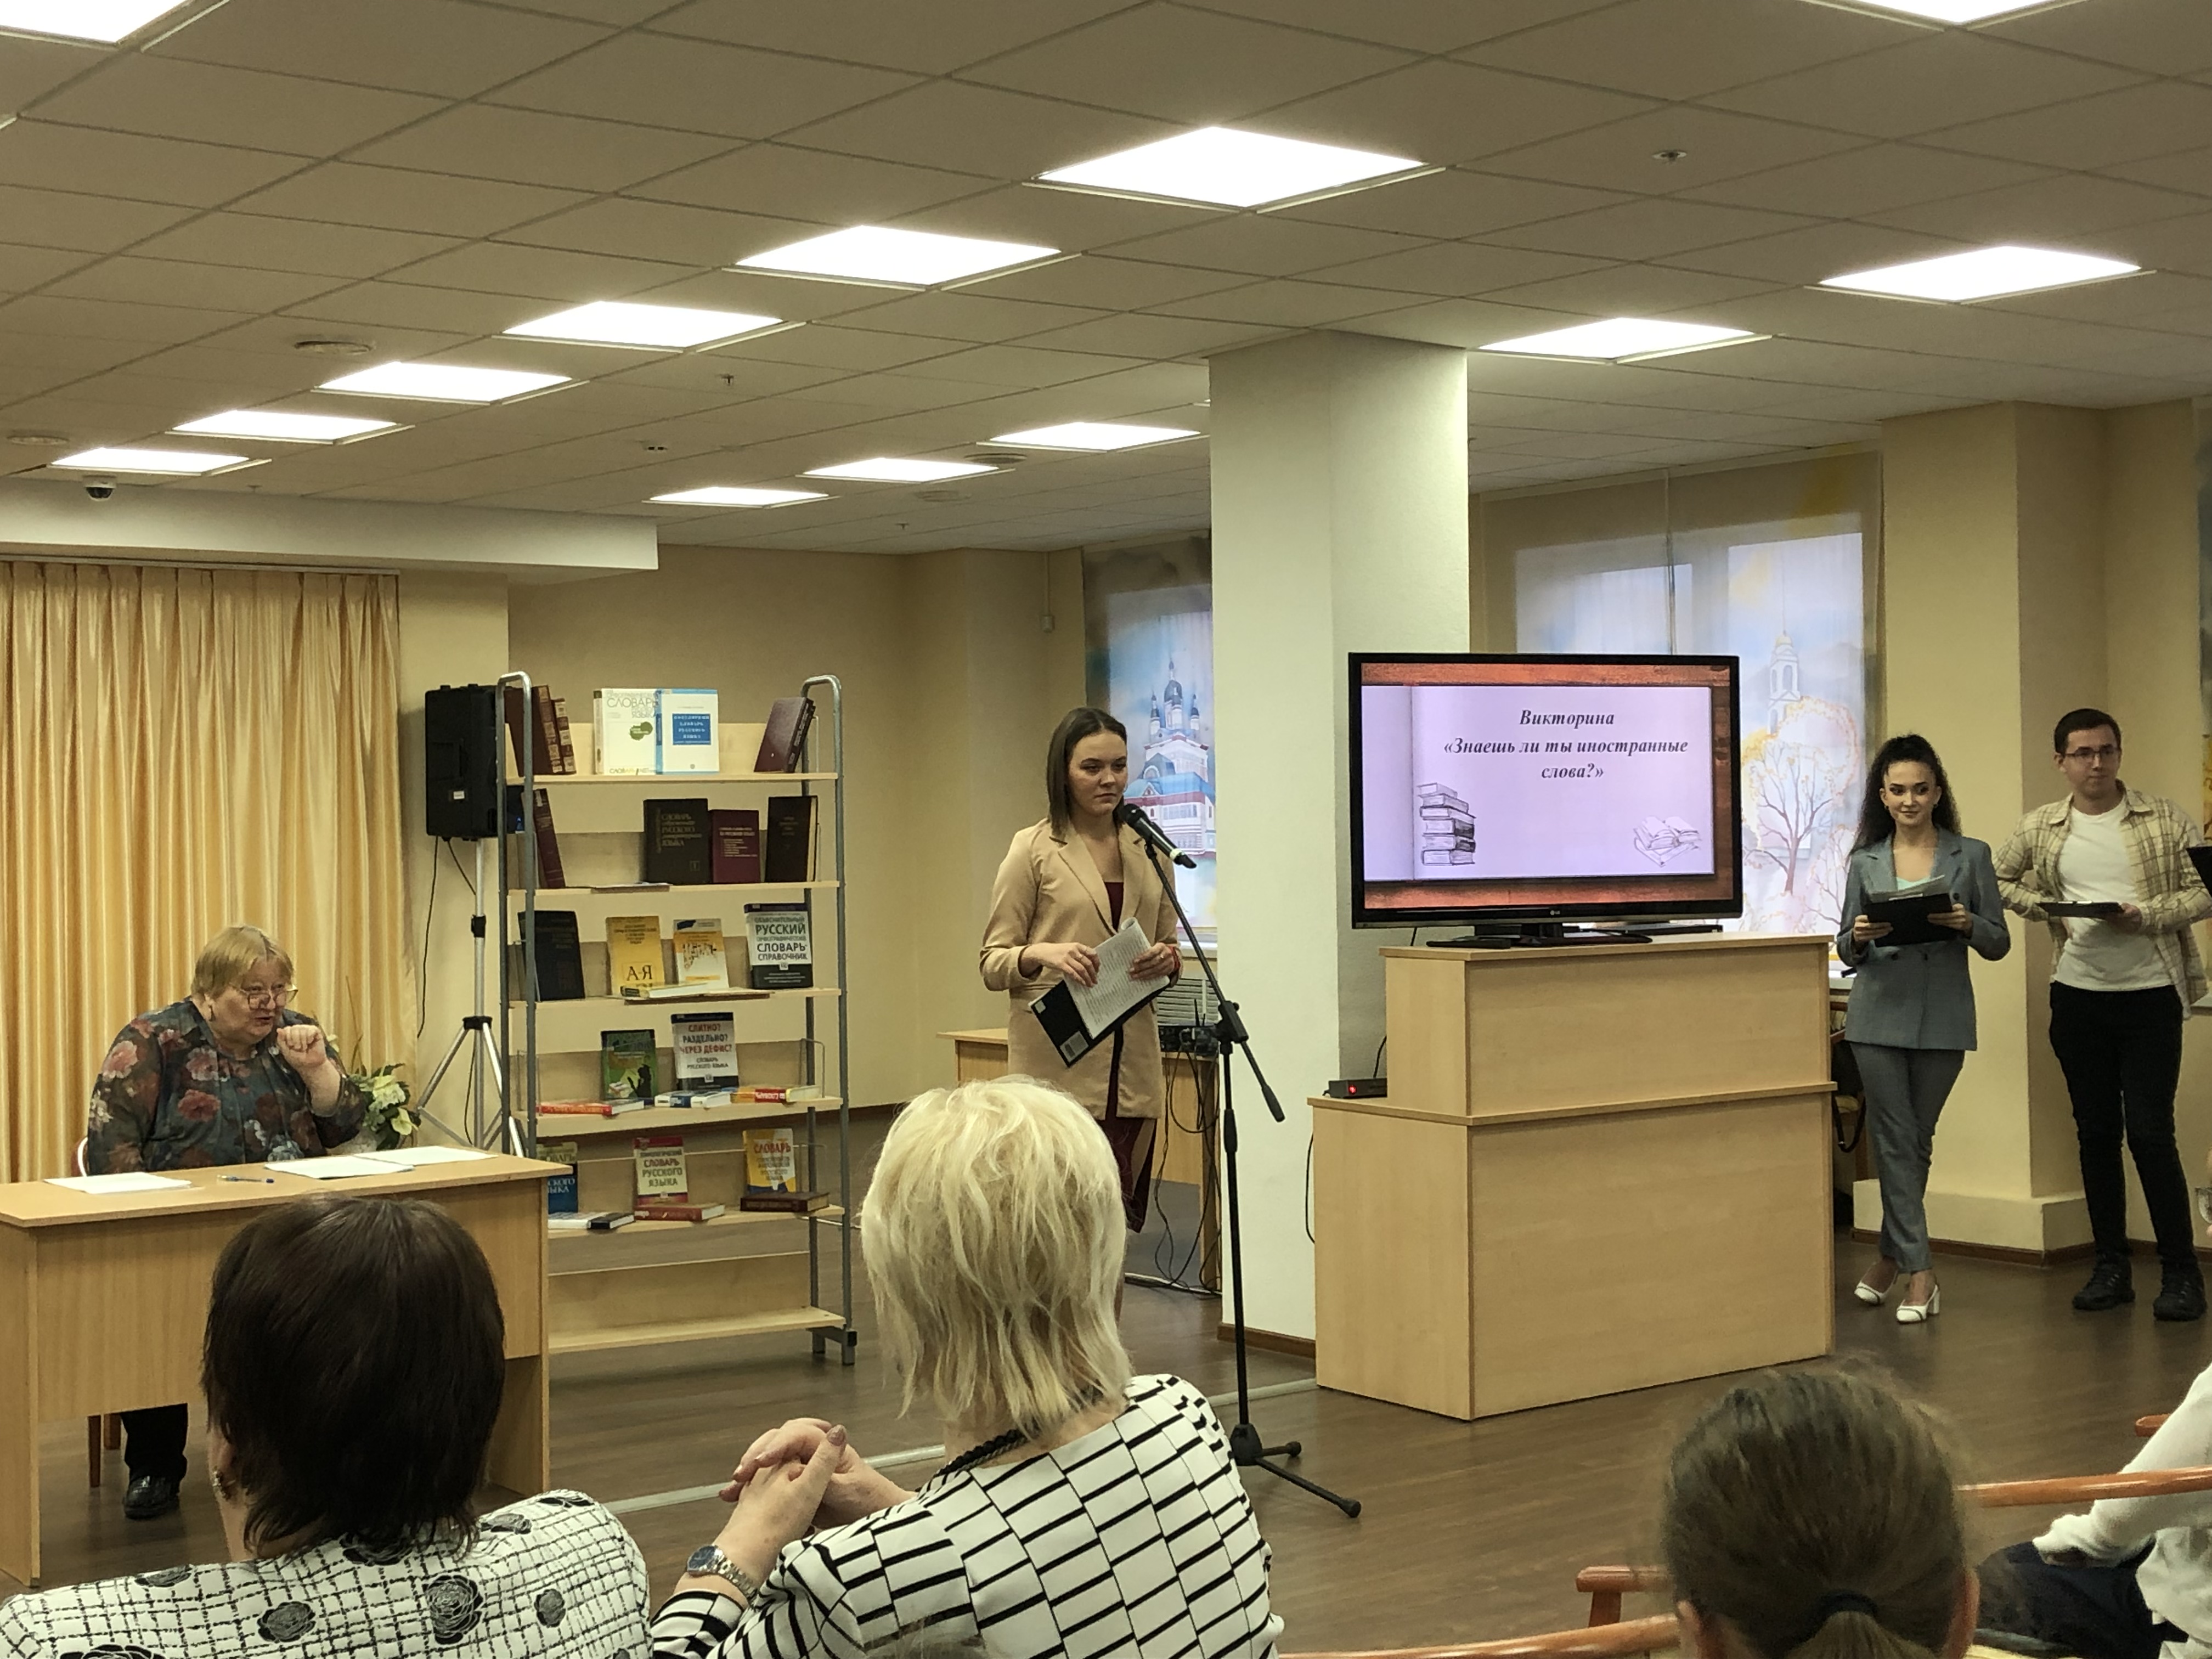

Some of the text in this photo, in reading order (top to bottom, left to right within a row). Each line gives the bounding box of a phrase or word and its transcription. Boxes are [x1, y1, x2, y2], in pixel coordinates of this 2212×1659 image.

[1519, 709, 1615, 729] Викторина
[1444, 737, 1688, 757] «Знаешь ли ты иностранные
[1541, 763, 1604, 778] слова?»
[755, 923, 806, 935] РУССКИЙ
[626, 964, 652, 981] А-Я
[689, 1024, 721, 1032] СЛИТНО?
[682, 1034, 728, 1043] РАЗДЕЛЬНО?
[680, 1044, 732, 1054] ЧЕРЕЗ ДЕФИС?
[753, 1143, 791, 1153] СЛОВАРЬ
[644, 1158, 680, 1167] СЛОВАРЬ
[642, 1167, 683, 1177] РУССКОГО
[548, 1178, 575, 1187] СКОГО
[648, 1178, 678, 1187] ЯЗЫКА
[548, 1186, 570, 1194] ЫКА
